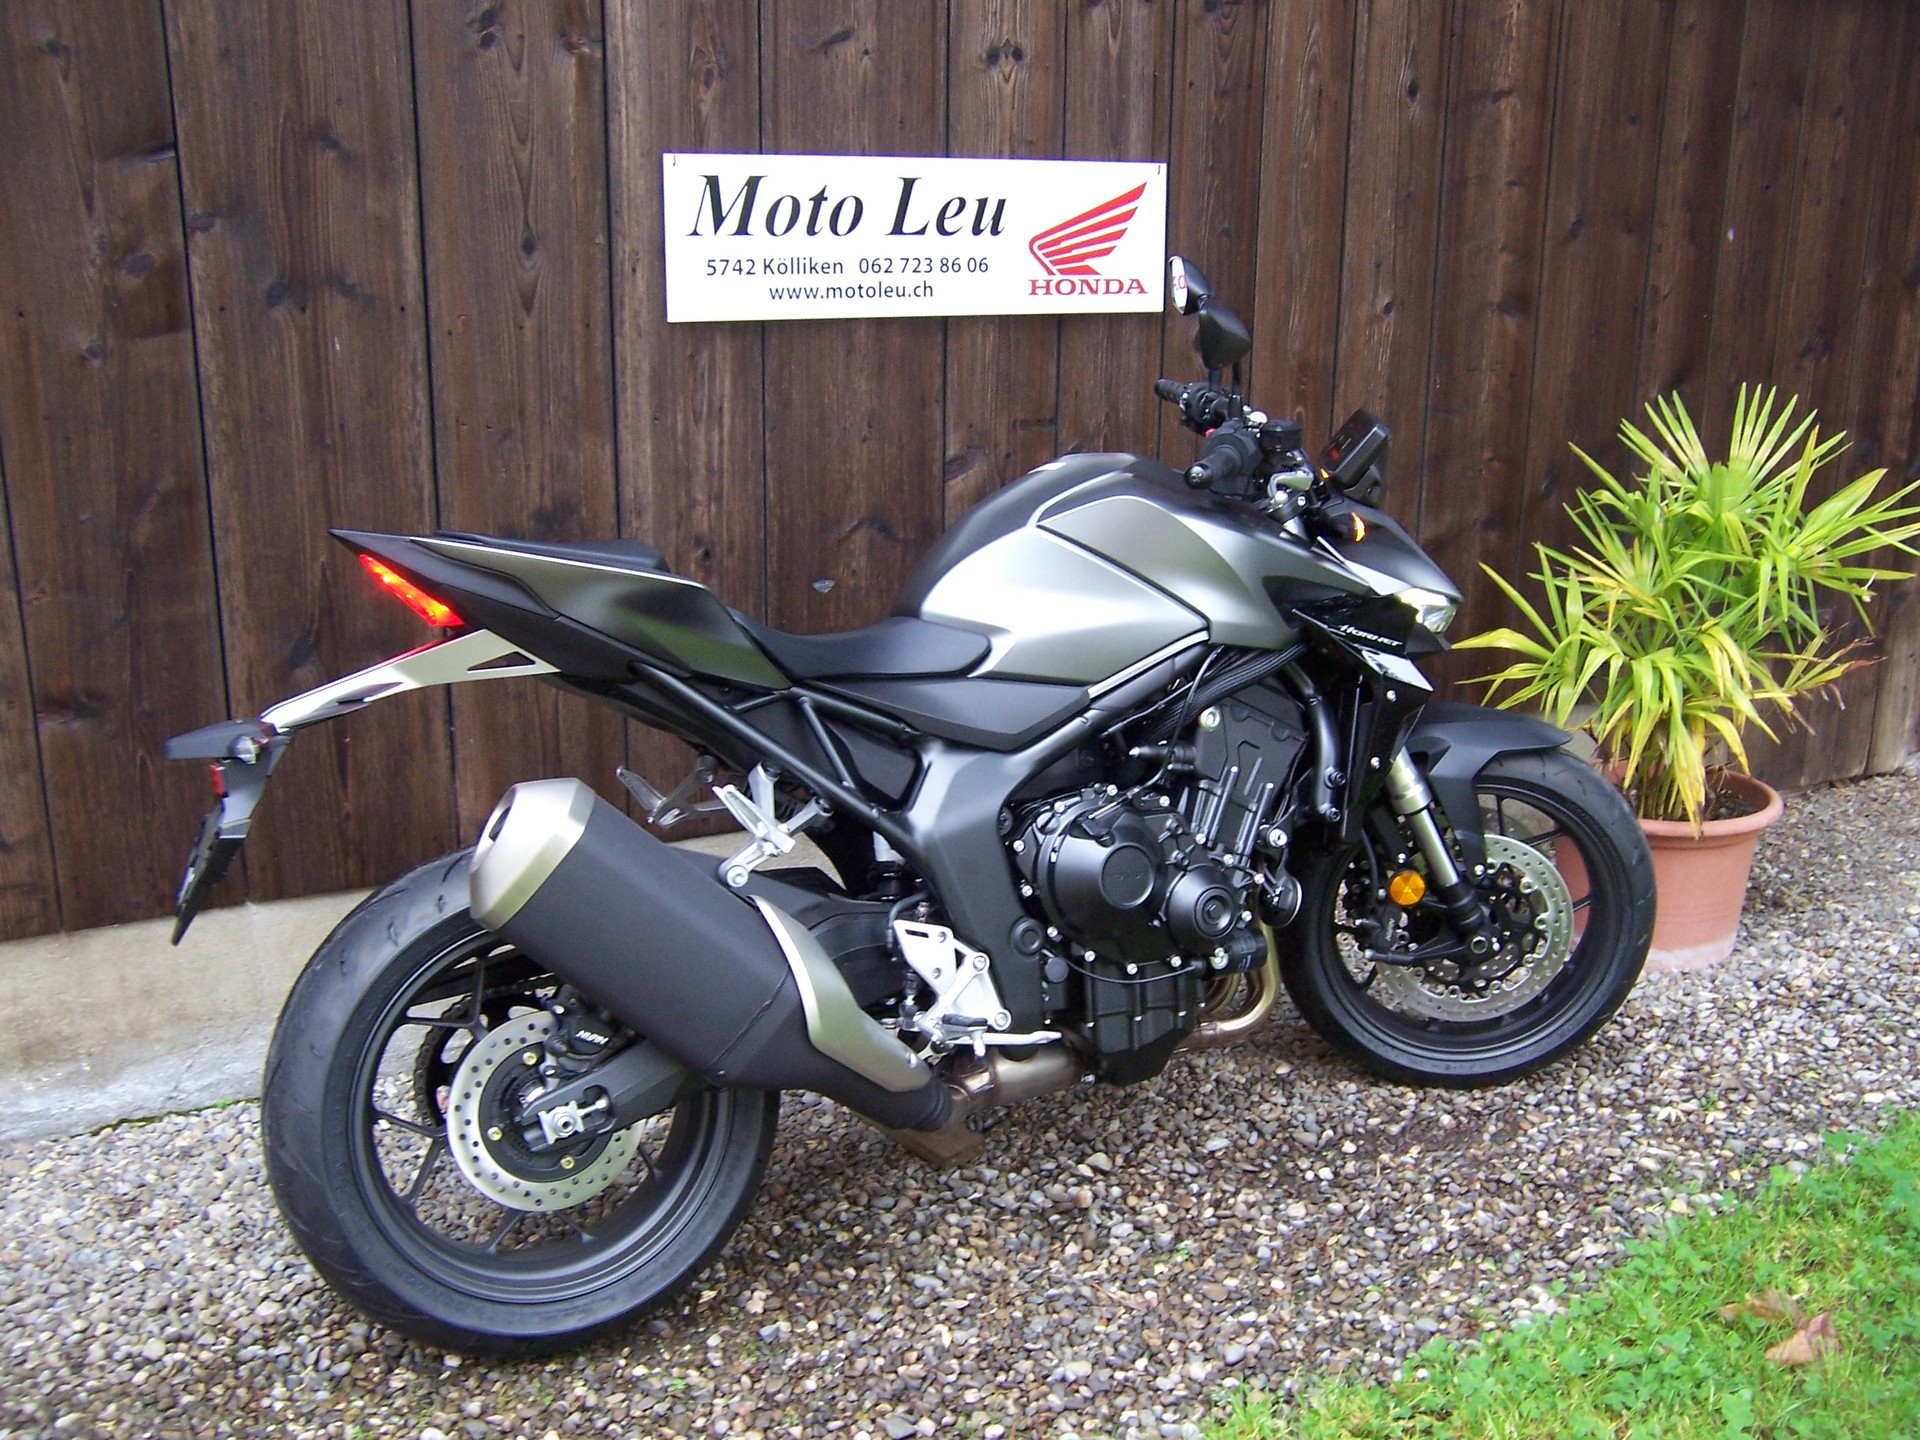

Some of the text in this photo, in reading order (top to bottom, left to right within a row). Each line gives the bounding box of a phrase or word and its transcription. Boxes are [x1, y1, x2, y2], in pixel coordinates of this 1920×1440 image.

[688, 174, 1007, 237] Moto Leu
[706, 256, 989, 276] 5742 Kölliken 062 723 86 06
[769, 281, 933, 300] www.motoleu.ch
[1029, 278, 1147, 296] HONDA
